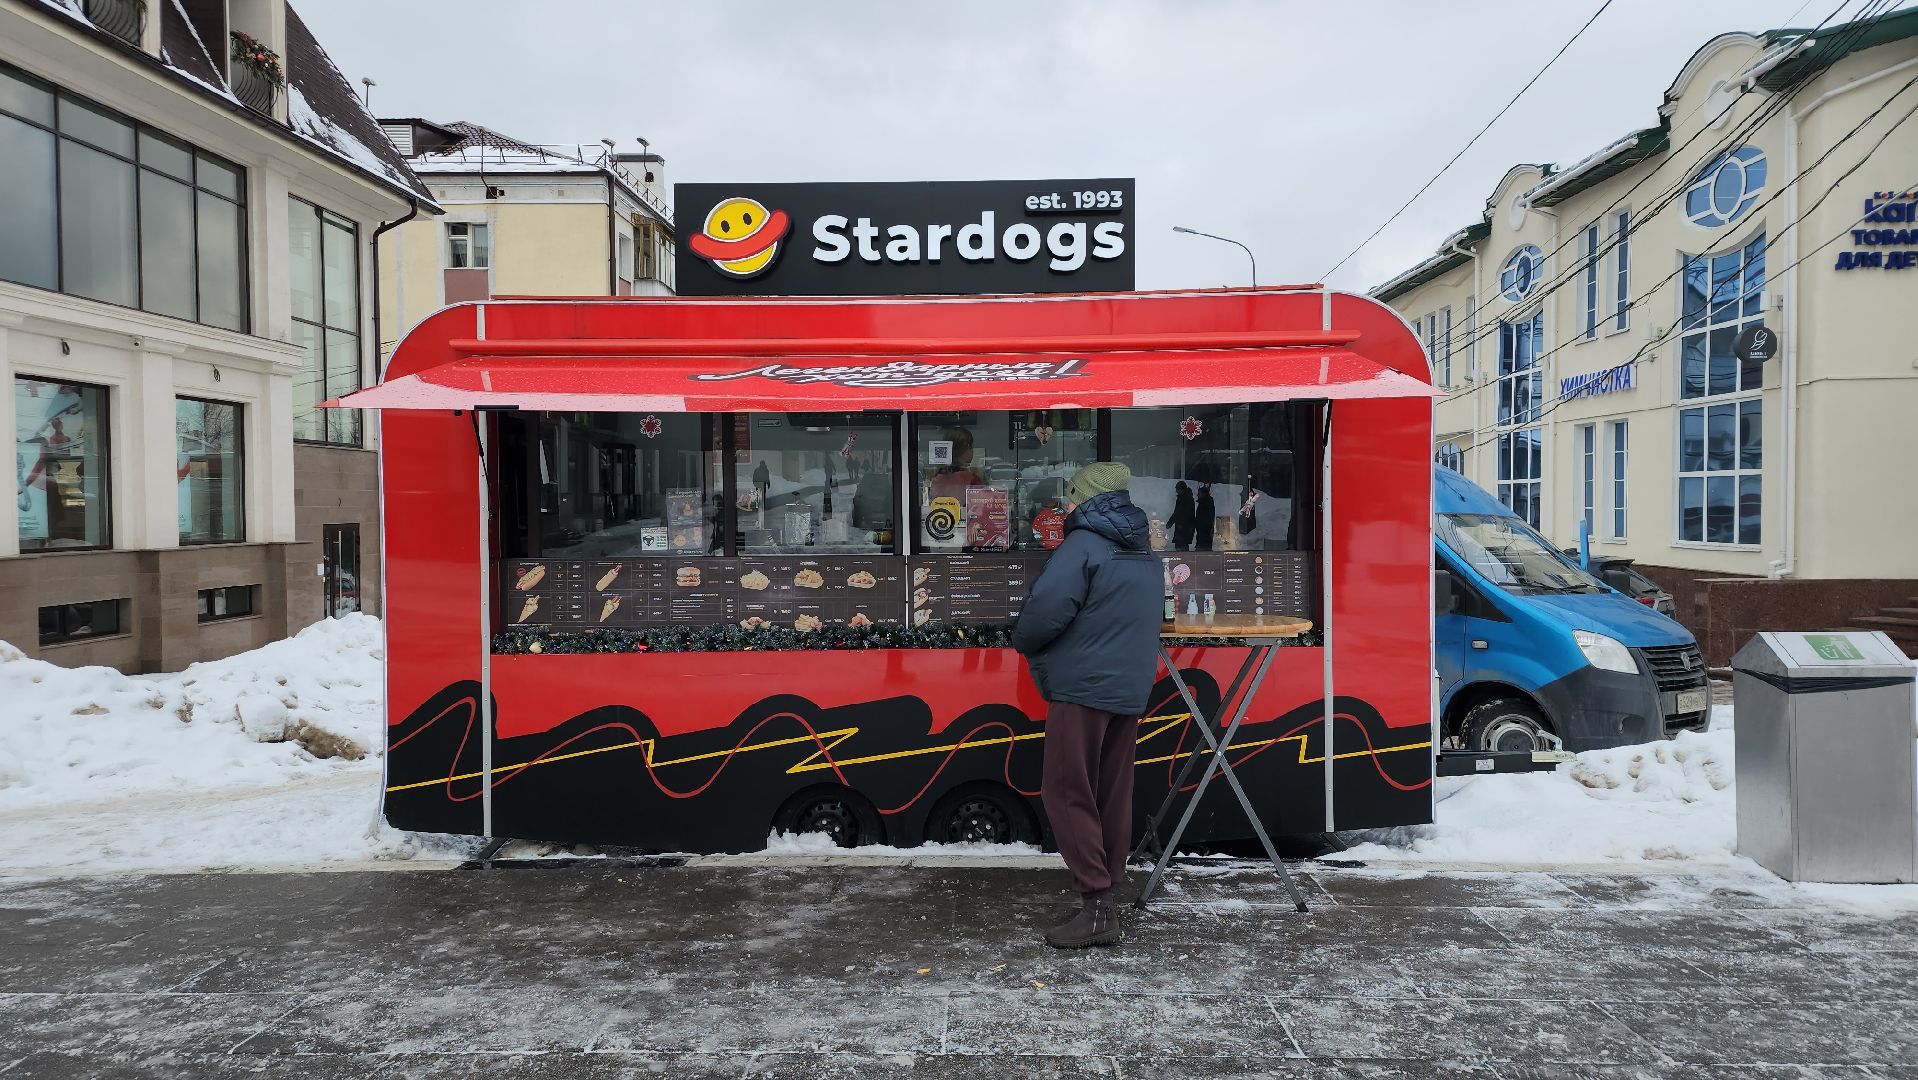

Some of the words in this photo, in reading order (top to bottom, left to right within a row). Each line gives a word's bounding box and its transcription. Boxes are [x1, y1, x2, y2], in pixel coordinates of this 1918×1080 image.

[1025, 191, 1067, 209] est.
[1072, 190, 1123, 209] 1993
[812, 210, 1126, 272] Stardogs
[1835, 251, 1882, 270] ДЛЯ
